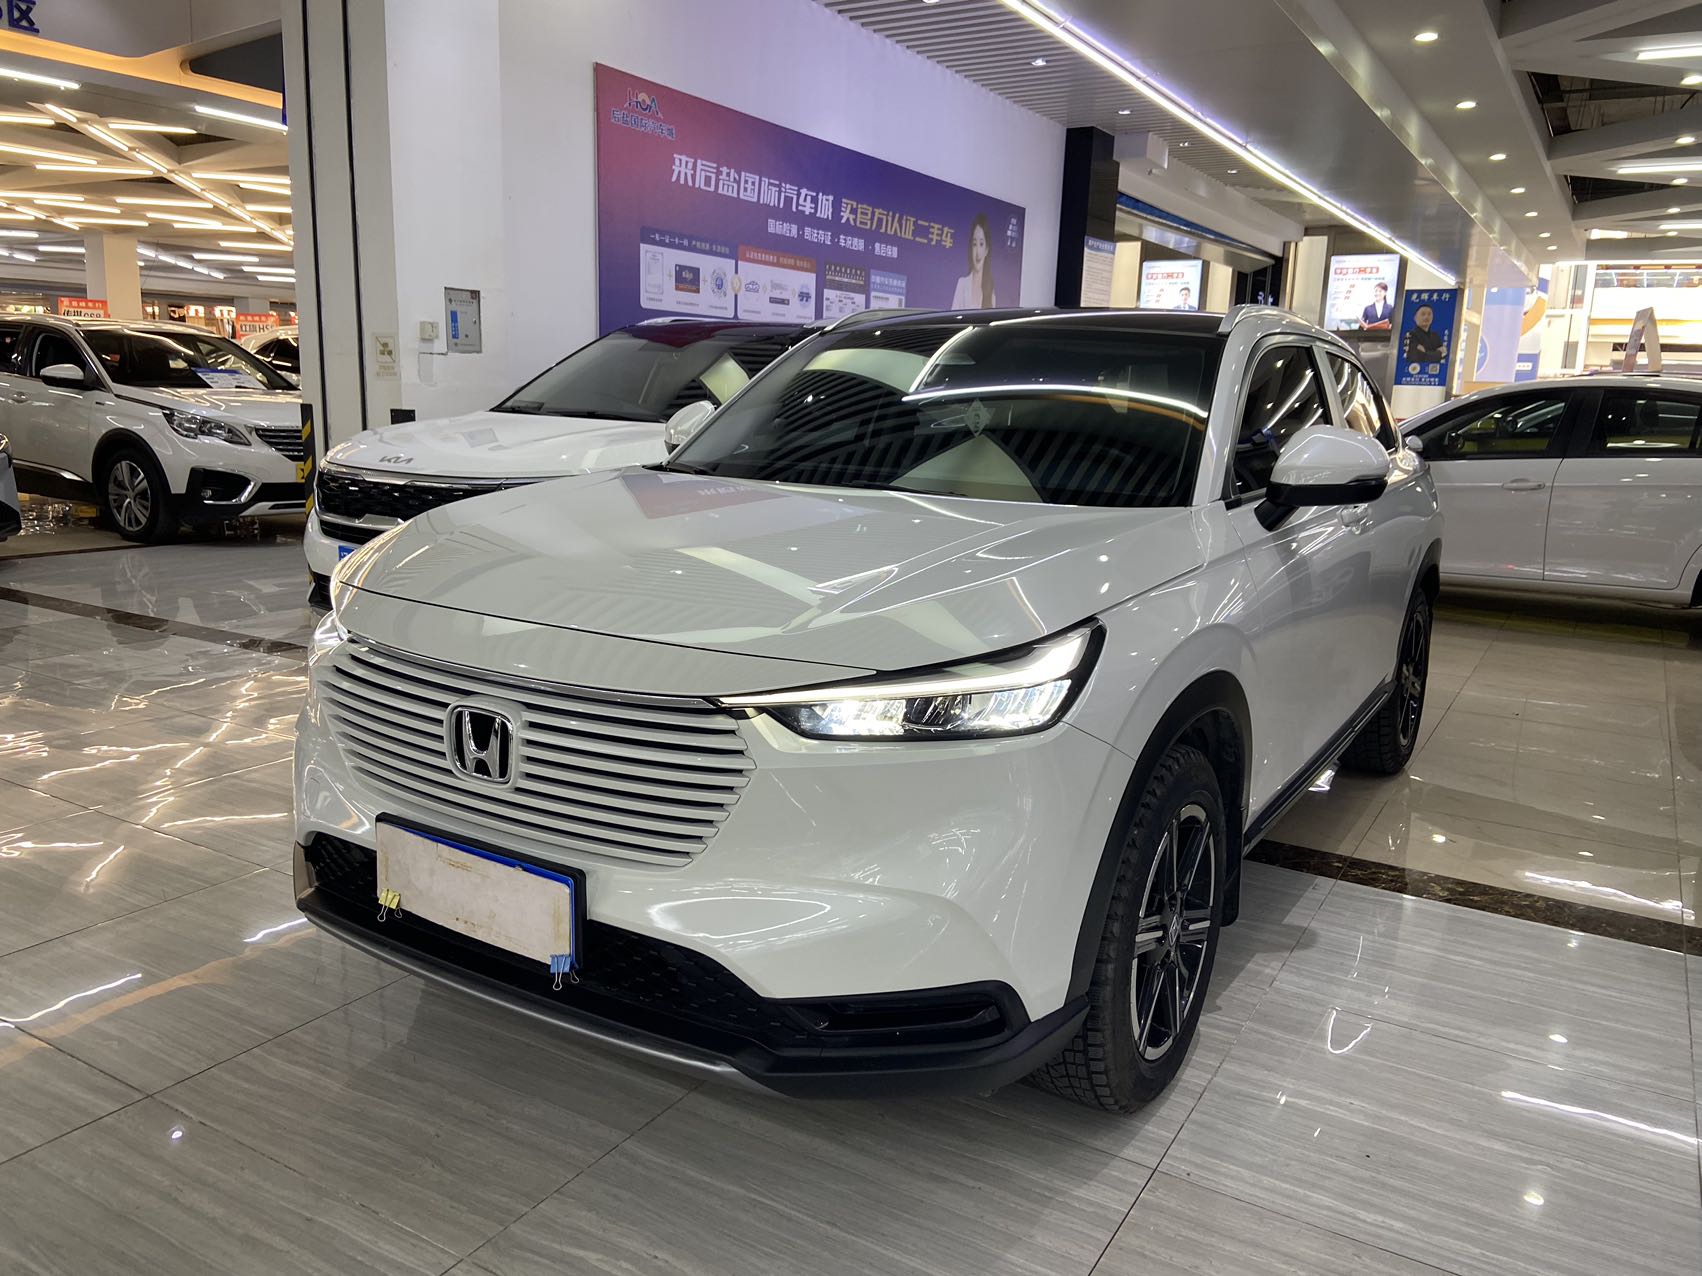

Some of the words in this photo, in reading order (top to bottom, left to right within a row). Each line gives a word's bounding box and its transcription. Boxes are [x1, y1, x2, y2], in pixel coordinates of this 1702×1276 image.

[0, 0, 40, 33] 区
[611, 108, 676, 140] 后盐国际汽车城
[671, 153, 834, 221] 来后盐国际汽车城
[841, 198, 955, 249] 买官方认证二手车
